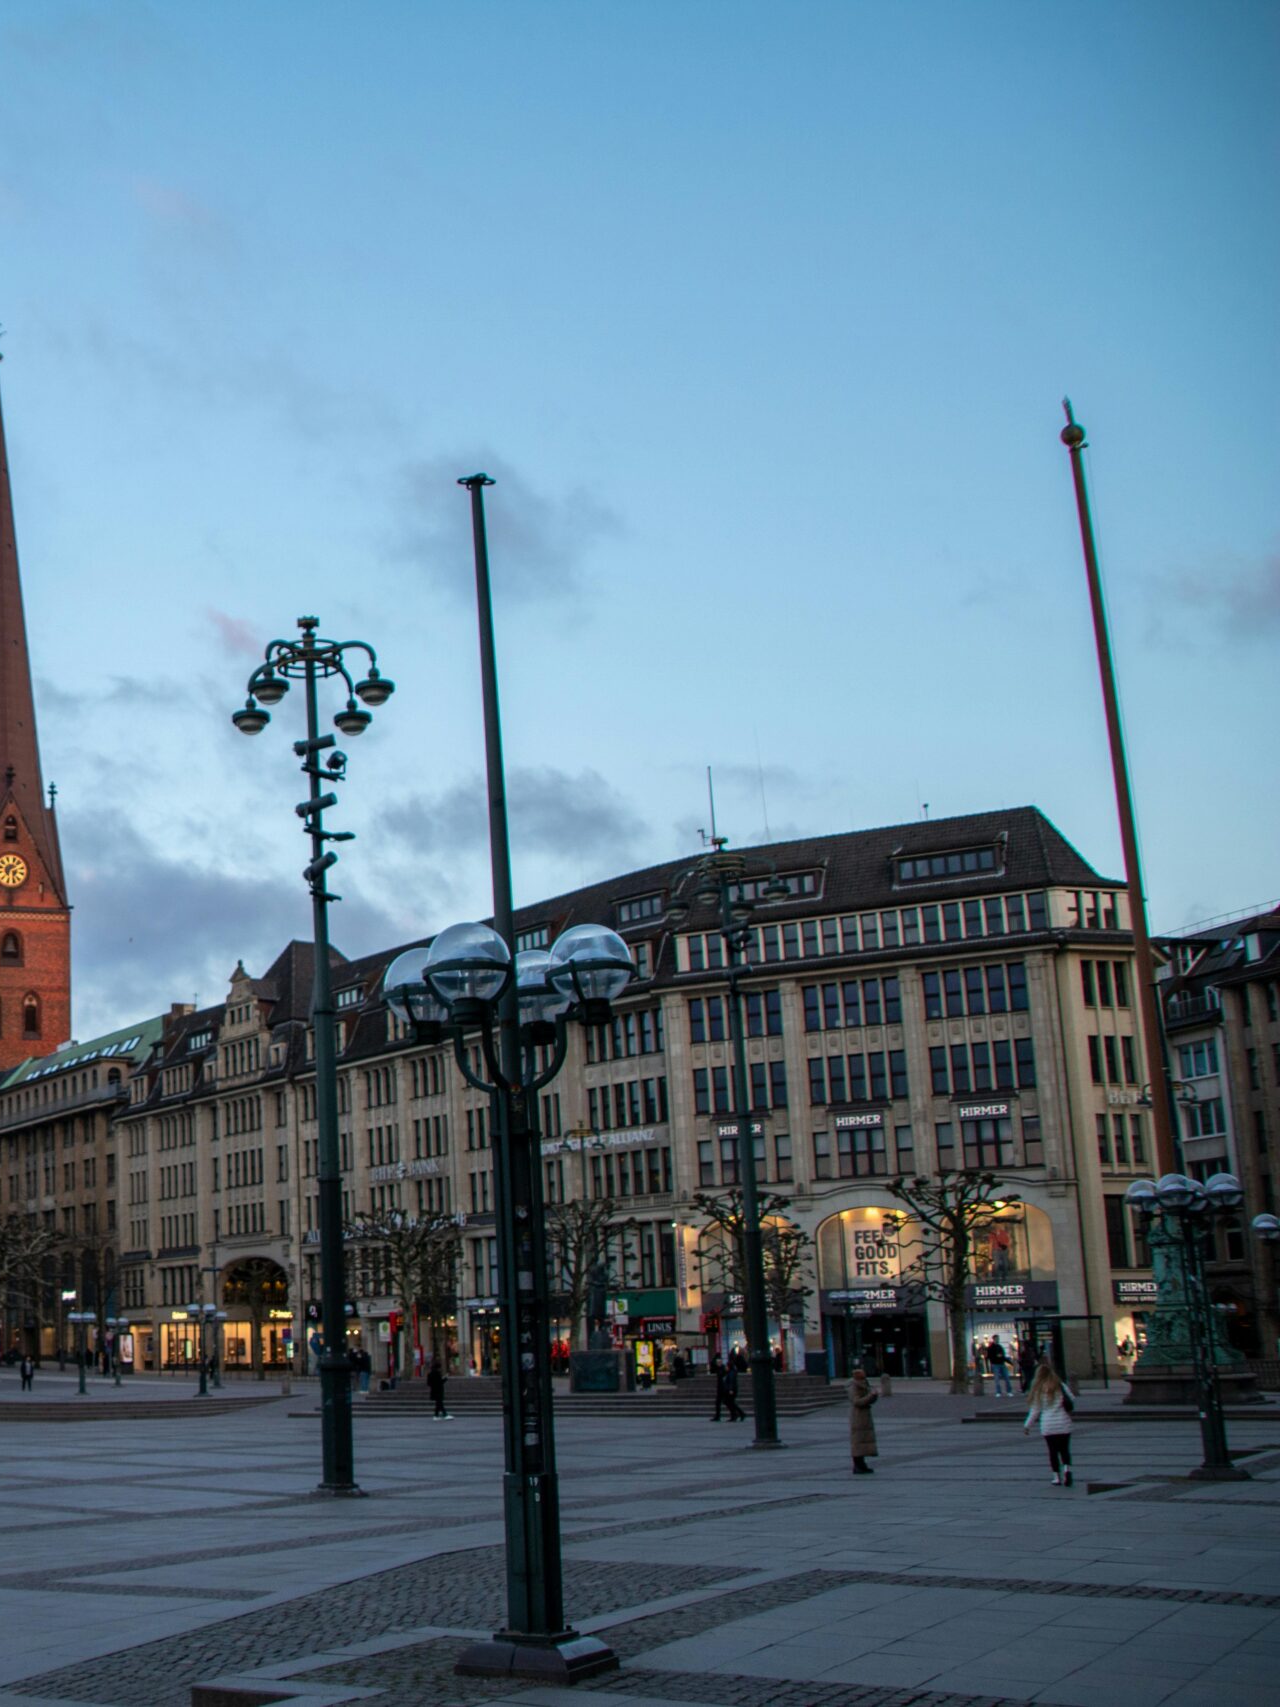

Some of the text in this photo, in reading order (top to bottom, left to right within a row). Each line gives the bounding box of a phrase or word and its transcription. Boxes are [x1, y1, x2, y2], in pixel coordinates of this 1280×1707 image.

[960, 1105, 1008, 1118] HIRMER
[836, 1114, 881, 1127] HIRMER
[719, 1123, 762, 1136] HIRR
[855, 1245, 897, 1260] GOOD
[856, 1261, 893, 1276] FITS.
[975, 1285, 1024, 1296] HIRMER
[1119, 1282, 1157, 1292] HIRME
[862, 1289, 897, 1299] RMER
